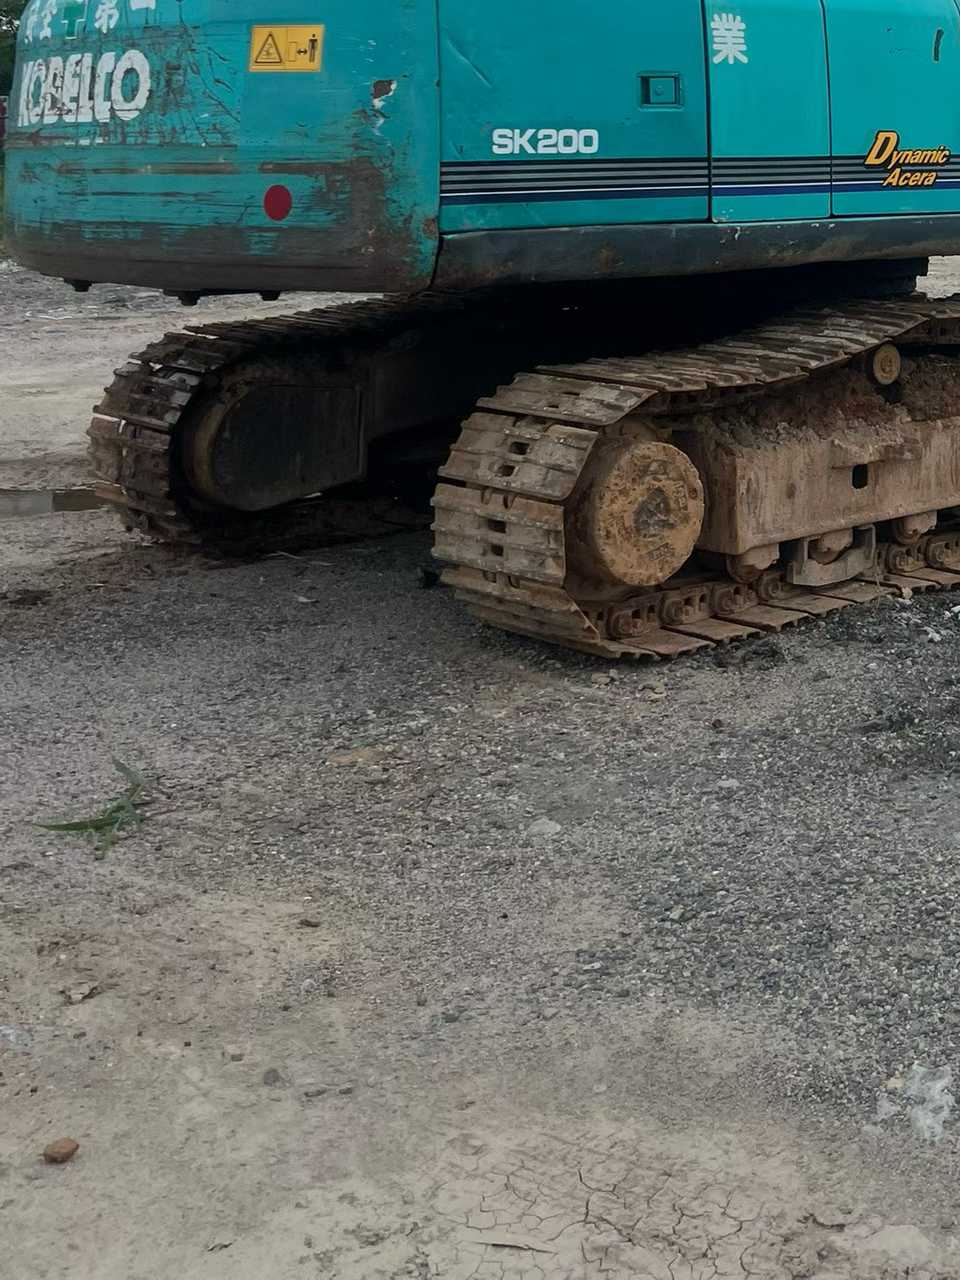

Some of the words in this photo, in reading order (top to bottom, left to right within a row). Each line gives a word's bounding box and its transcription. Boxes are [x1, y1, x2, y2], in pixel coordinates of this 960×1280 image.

[710, 12, 748, 65] 業
[17, 49, 151, 128] KOBELCO
[491, 128, 599, 154] SK200
[864, 130, 951, 170] Dynamic
[881, 167, 937, 187] Acera
